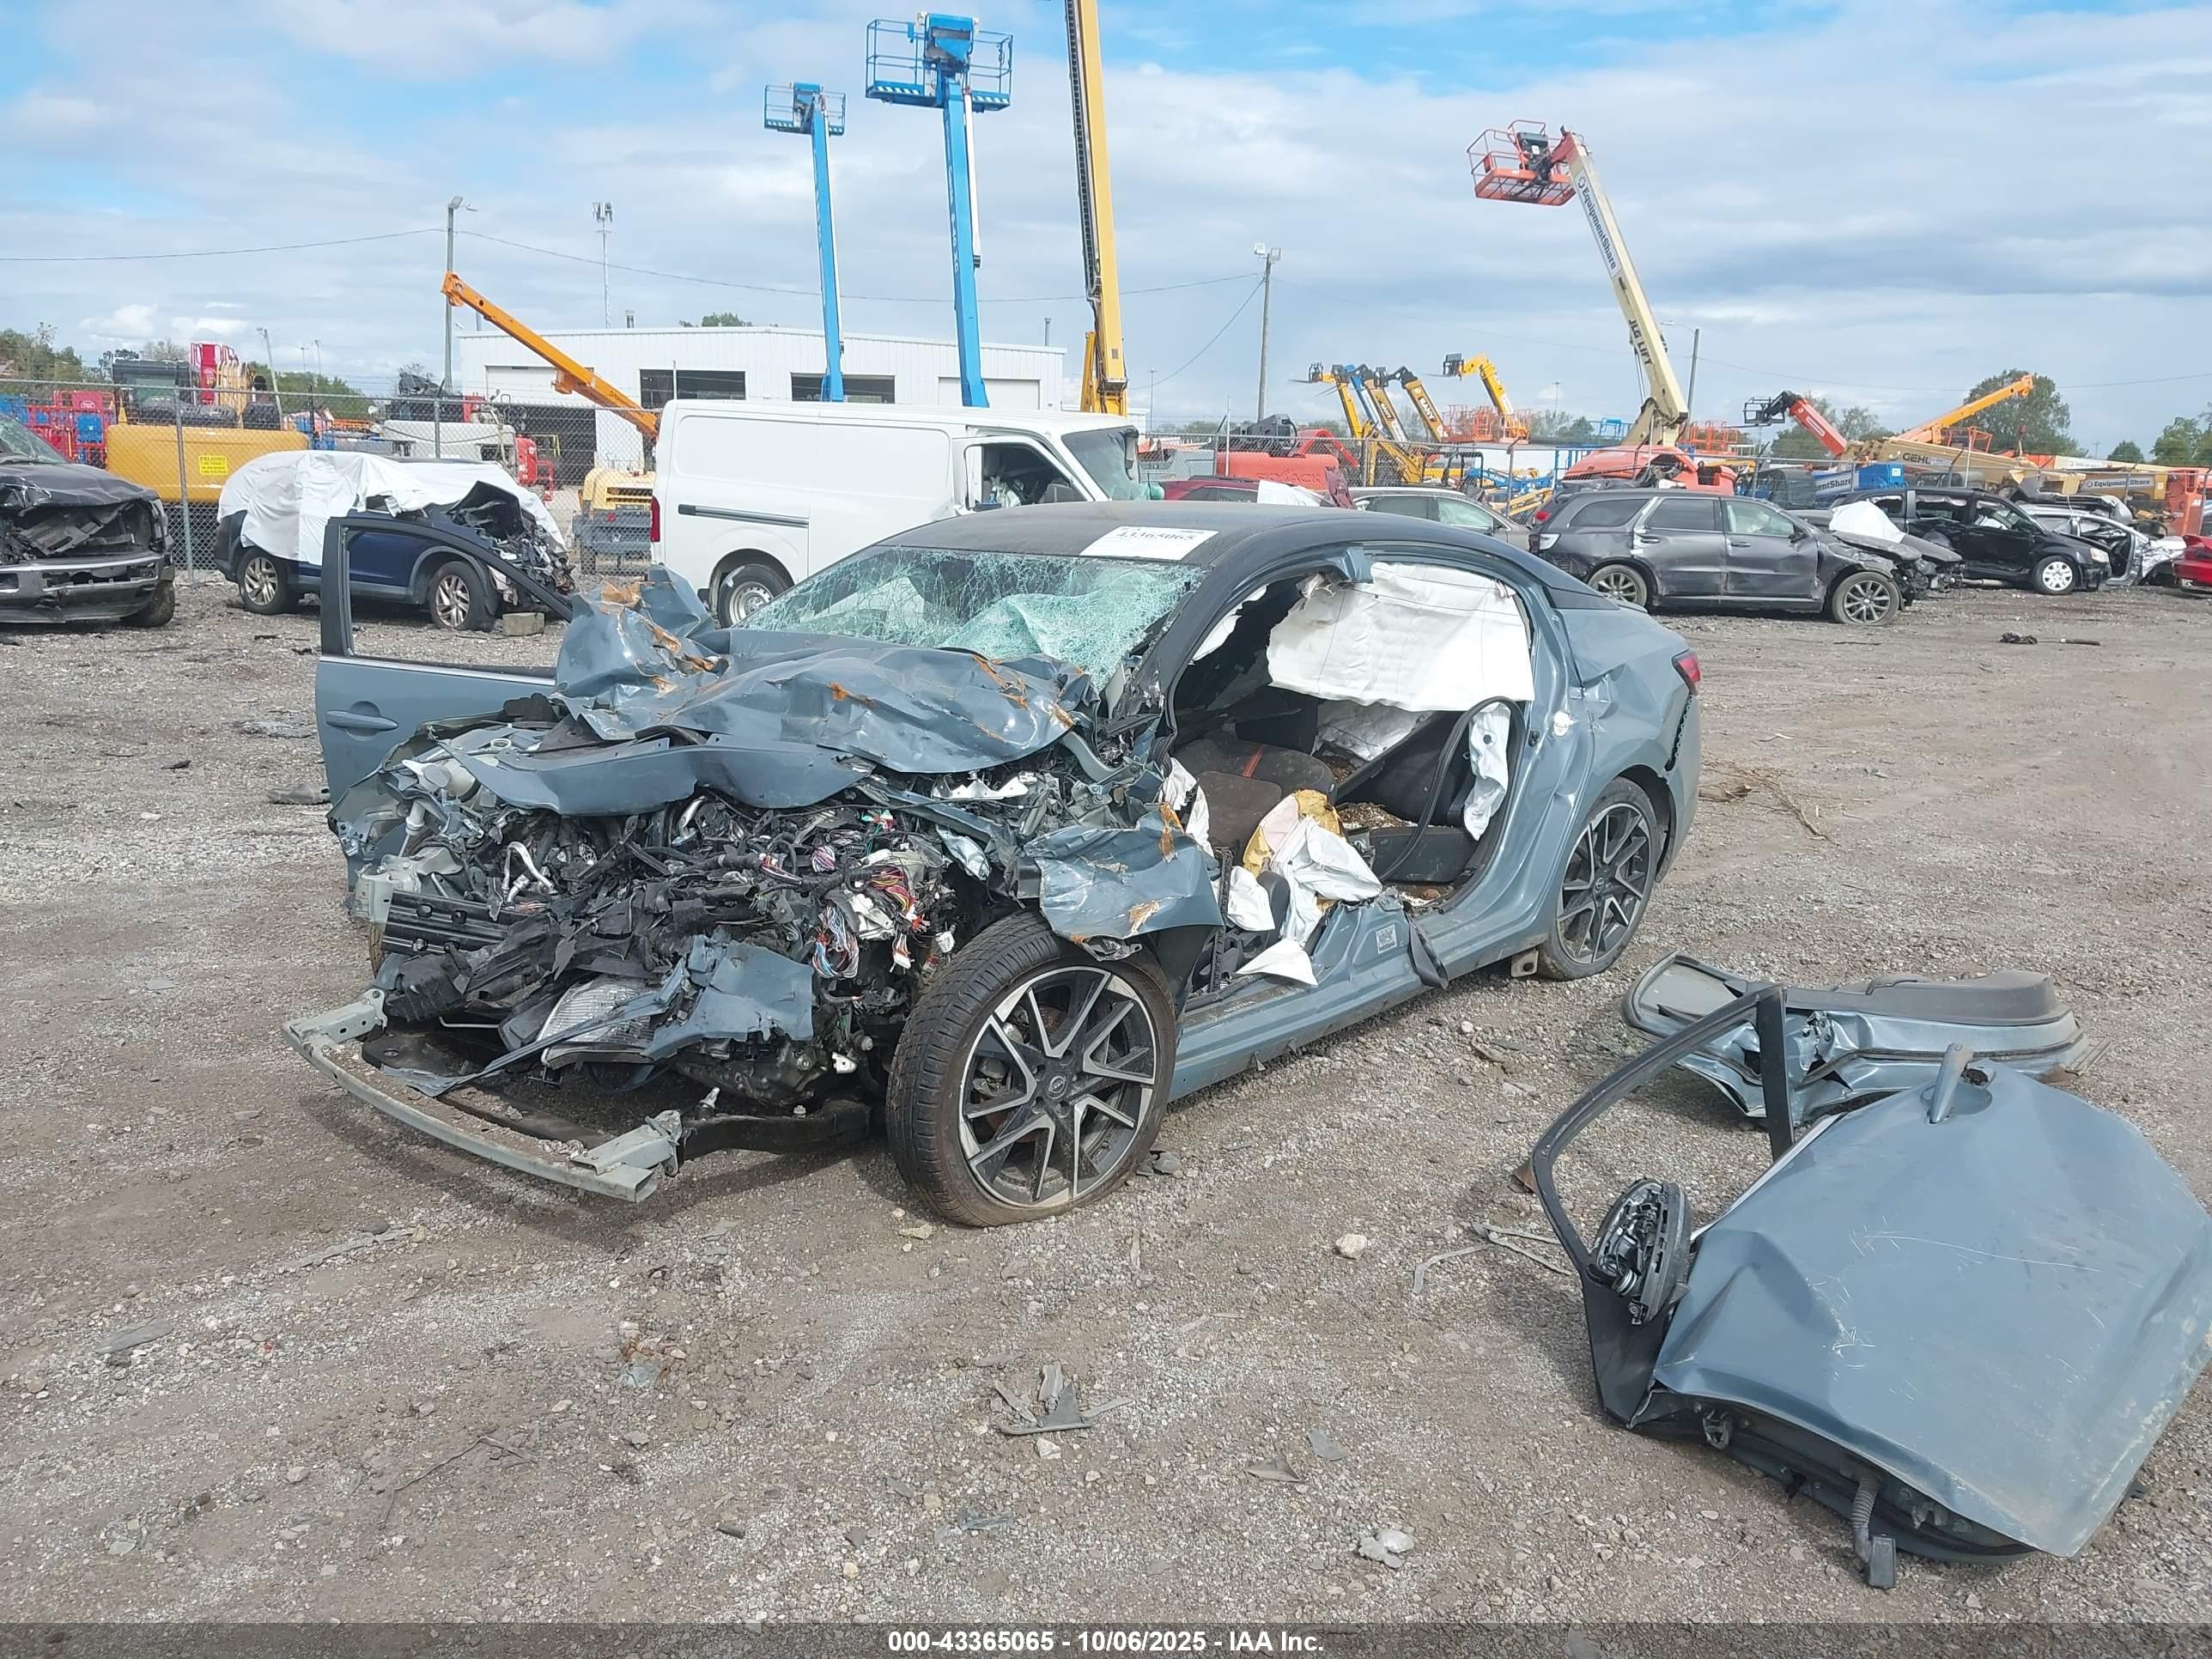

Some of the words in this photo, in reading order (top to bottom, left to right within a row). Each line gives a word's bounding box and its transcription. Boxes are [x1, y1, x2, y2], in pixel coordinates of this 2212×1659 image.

[1582, 186, 1616, 270] EquipmentShare
[1628, 319, 1642, 338] JLG
[1638, 341, 1652, 364] LIFT
[1419, 398, 1436, 421] SANY
[1902, 453, 1931, 465] GEHL
